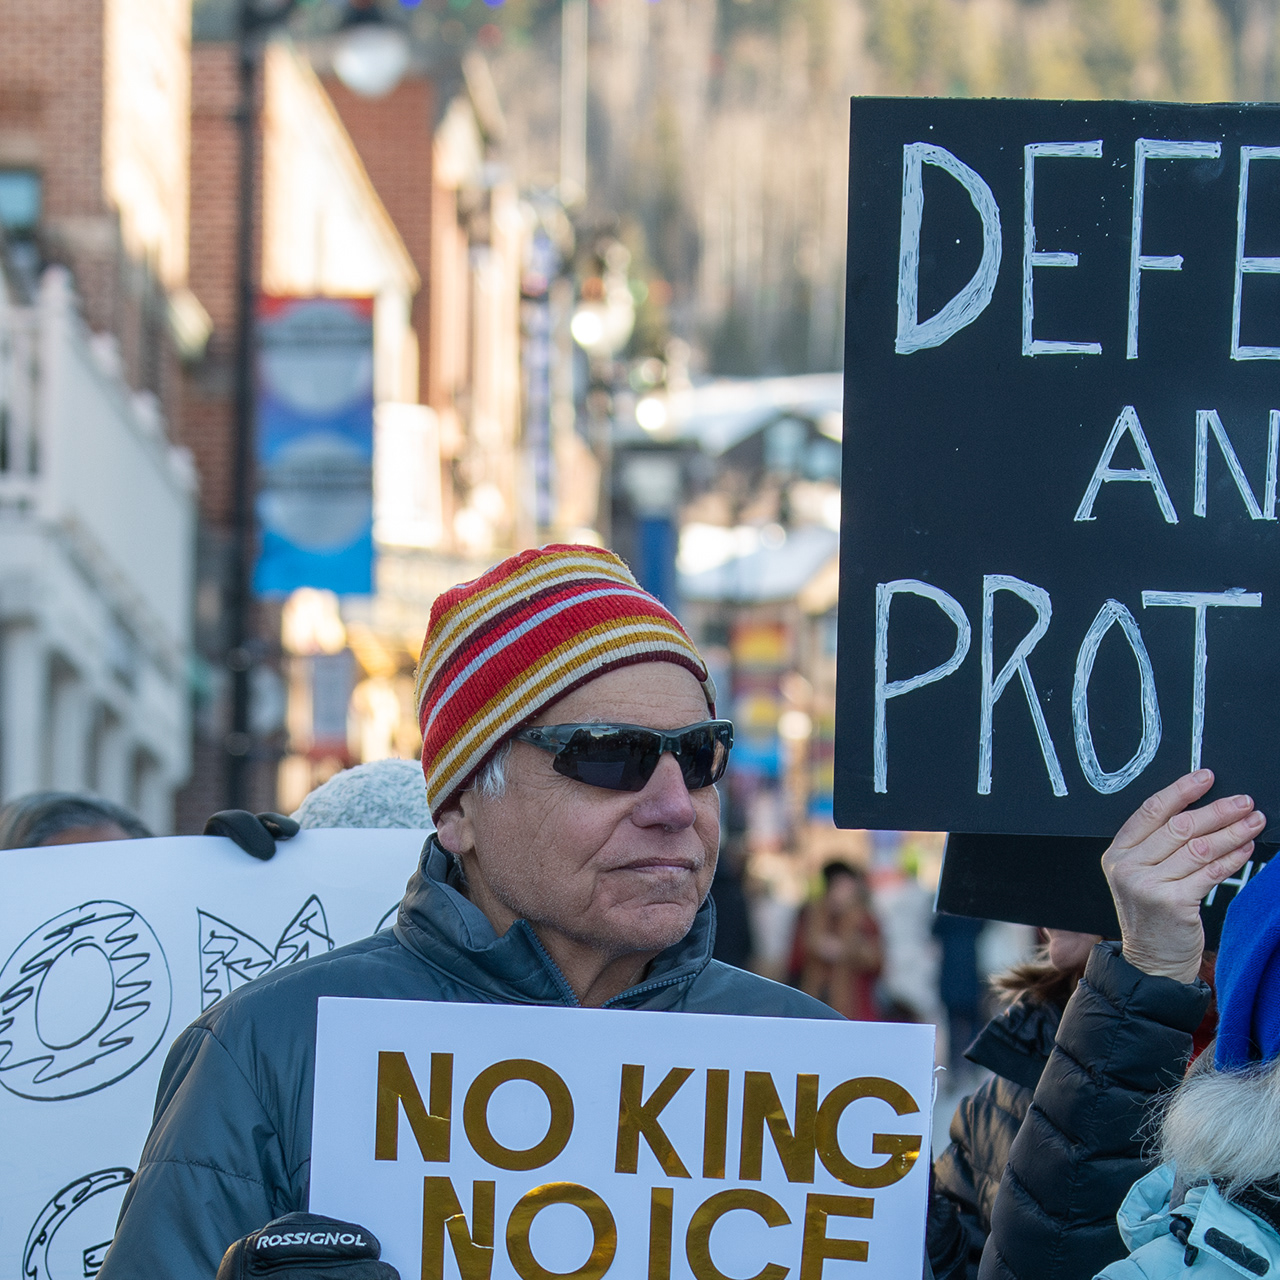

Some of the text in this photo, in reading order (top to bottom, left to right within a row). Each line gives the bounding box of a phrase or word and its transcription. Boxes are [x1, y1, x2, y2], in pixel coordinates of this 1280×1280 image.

[375, 1051, 922, 1188] NO KING
[256, 1232, 367, 1250] ROSSIGNOL
